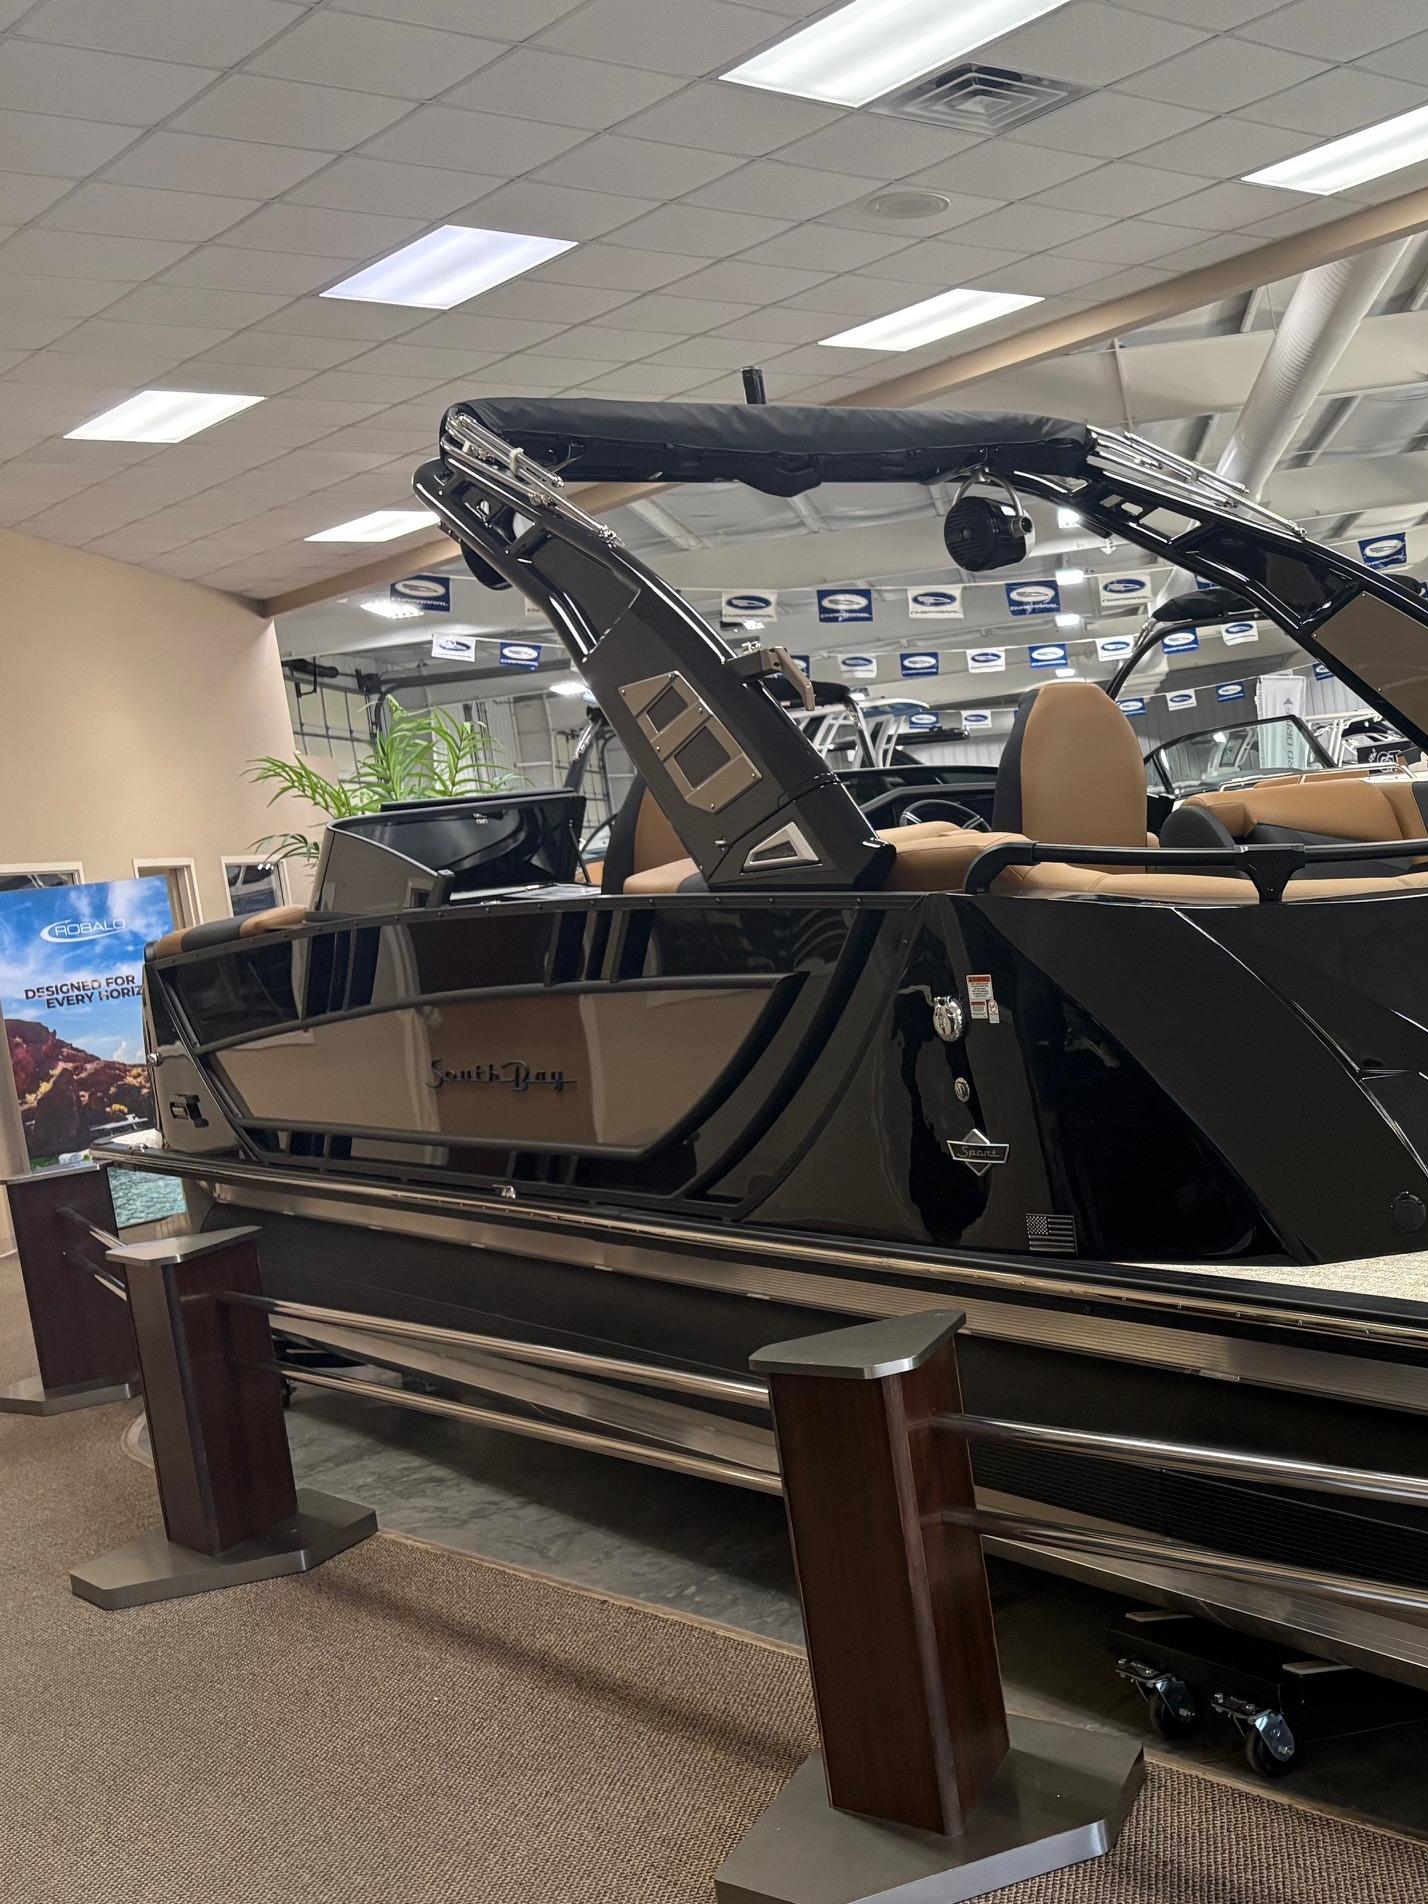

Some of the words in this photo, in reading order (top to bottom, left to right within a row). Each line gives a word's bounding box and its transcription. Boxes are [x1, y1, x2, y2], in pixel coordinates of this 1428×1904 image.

[54, 918, 126, 938] ROBALO
[24, 978, 102, 1001] DESIGNED
[105, 974, 136, 990] FOR
[46, 990, 94, 1010] EVERY
[425, 1059, 500, 1089] South
[502, 1059, 568, 1093] Bay
[957, 1145, 1000, 1158] Sport
